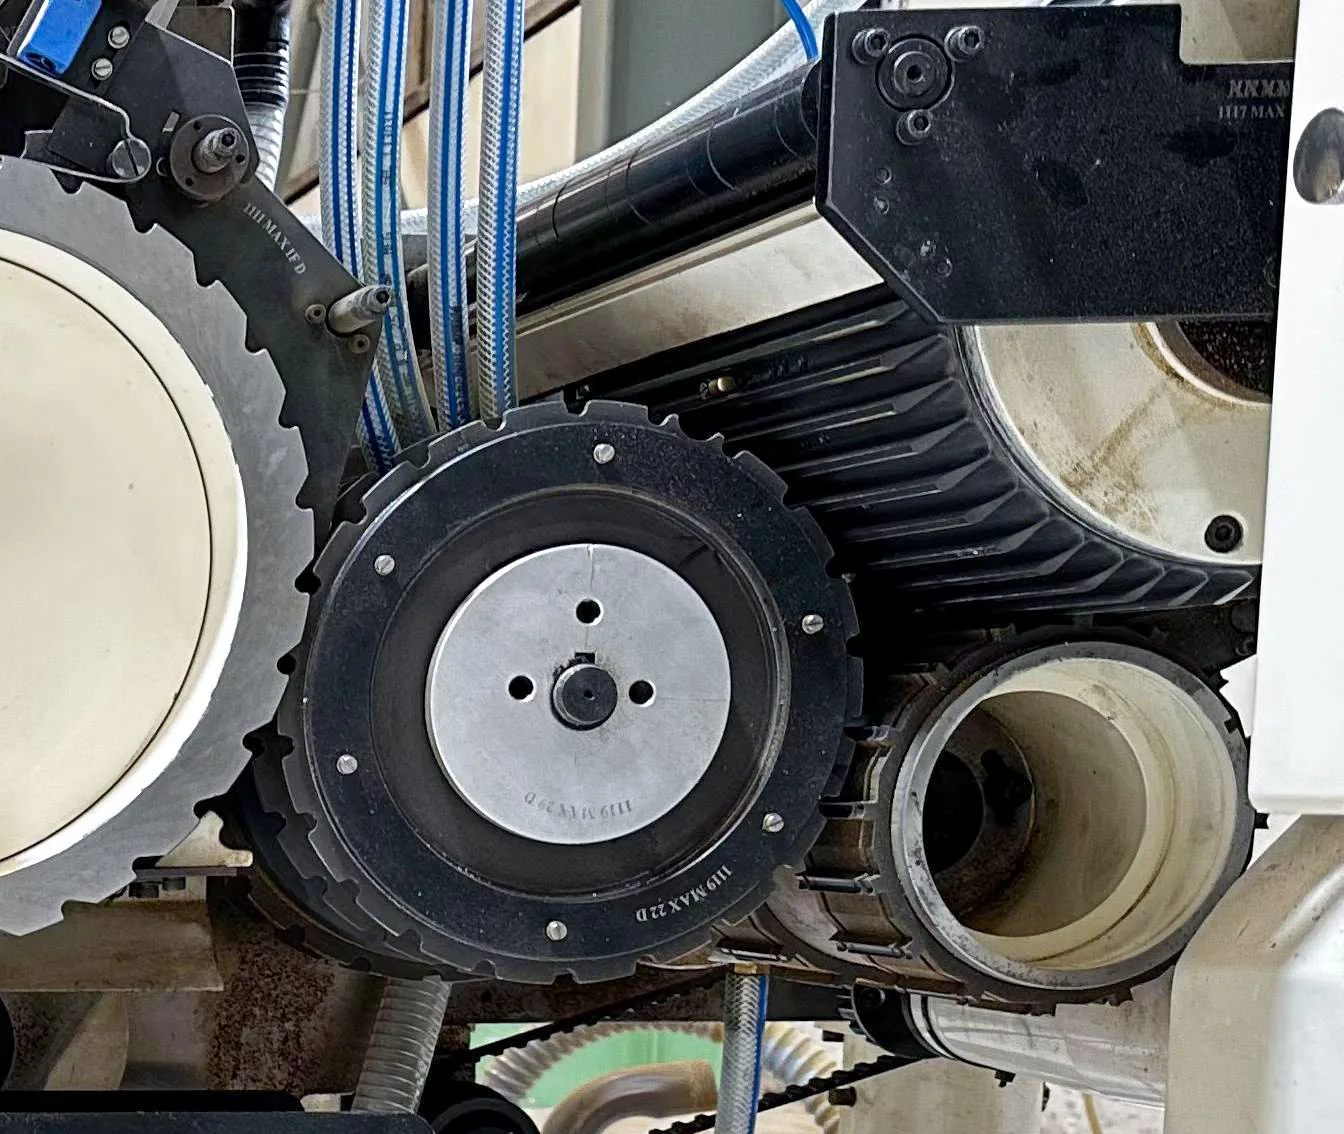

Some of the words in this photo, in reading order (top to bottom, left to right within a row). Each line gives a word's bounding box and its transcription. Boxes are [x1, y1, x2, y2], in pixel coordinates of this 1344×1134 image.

[262, 218, 291, 250] MAX
[706, 865, 732, 891] 1119
[650, 903, 667, 919] 22
[668, 884, 708, 914] MAX
[636, 907, 648, 922] D
